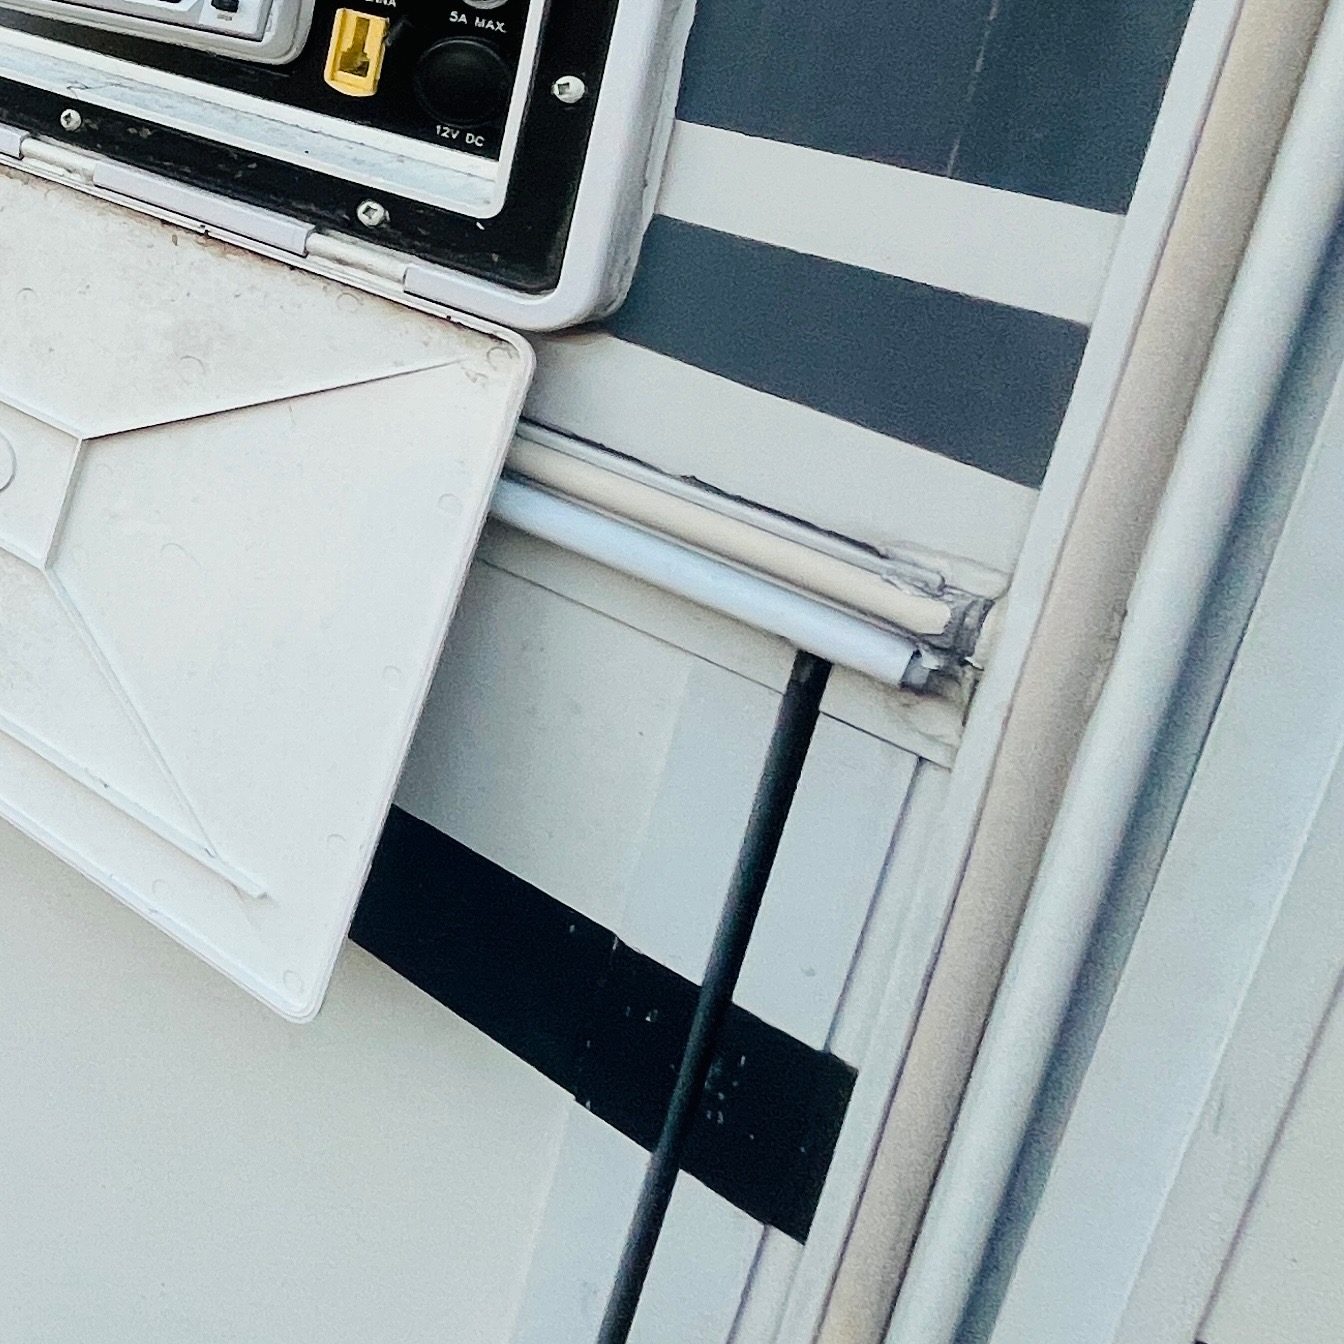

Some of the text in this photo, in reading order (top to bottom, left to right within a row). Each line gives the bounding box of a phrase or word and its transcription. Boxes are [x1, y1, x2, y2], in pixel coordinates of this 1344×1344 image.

[448, 10, 468, 25] 5A
[435, 124, 486, 148] 12V DC
